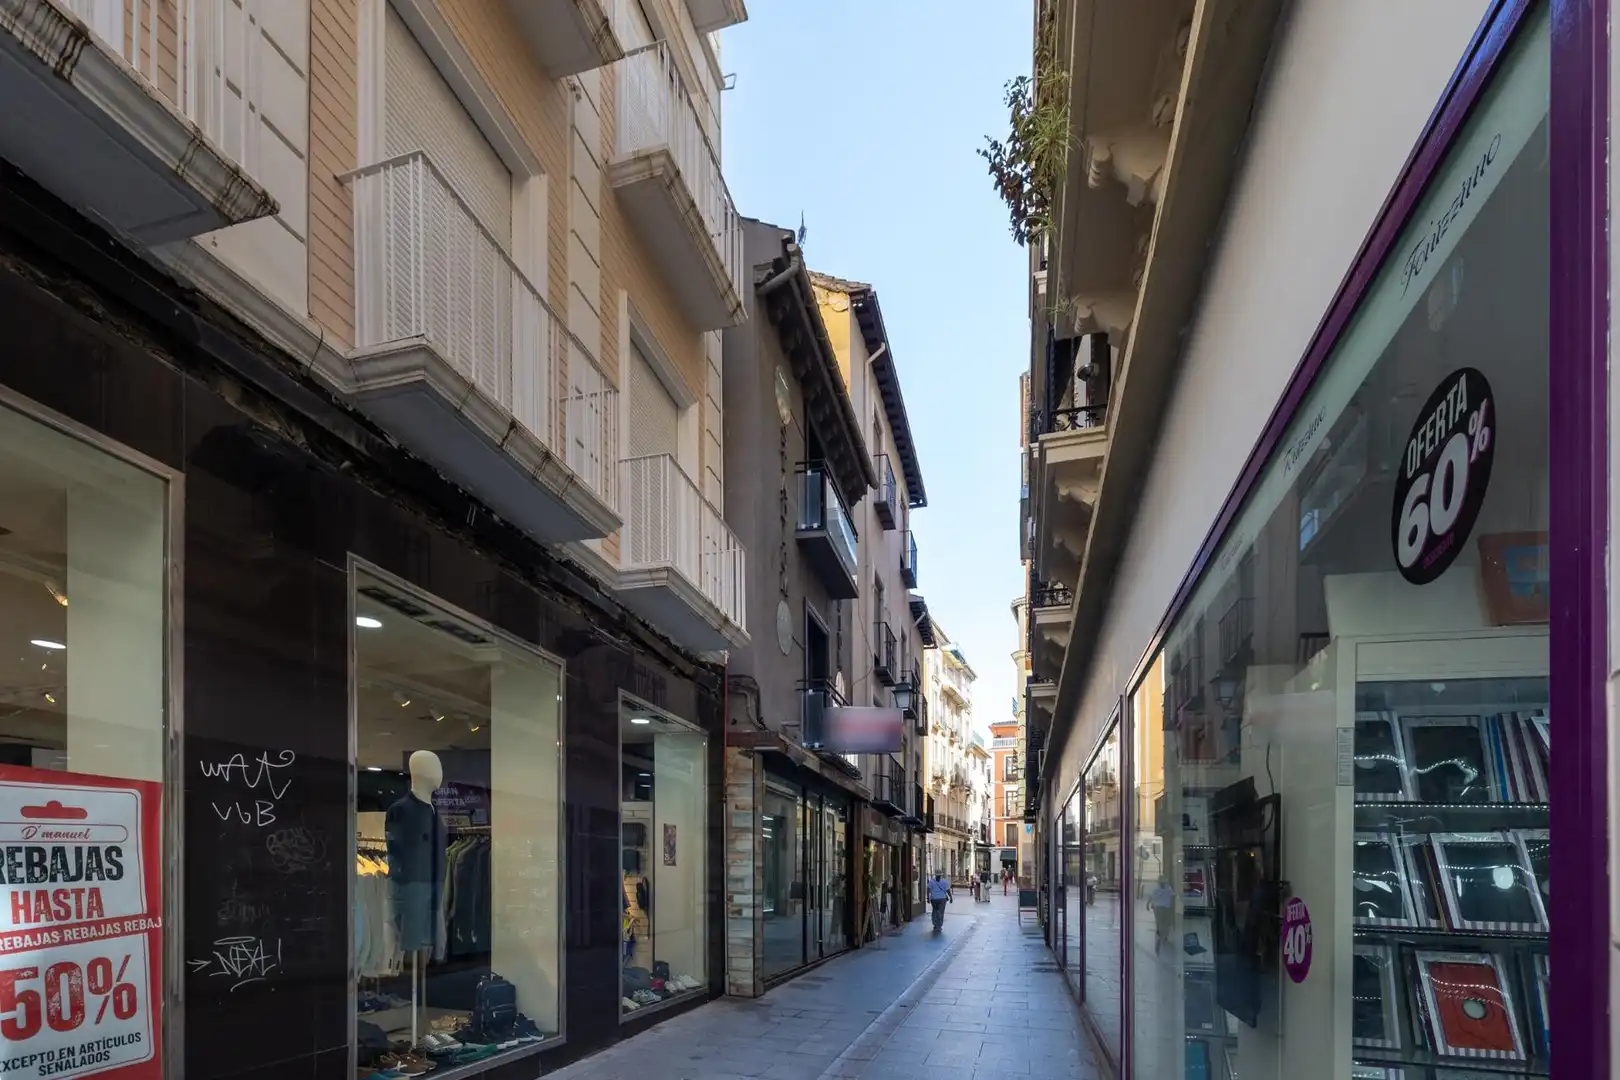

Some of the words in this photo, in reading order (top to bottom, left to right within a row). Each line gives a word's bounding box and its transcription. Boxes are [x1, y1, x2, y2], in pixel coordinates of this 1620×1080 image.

[1407, 373, 1468, 479] OFERTA
[1398, 398, 1492, 568] 60%
[10, 887, 105, 924] HASTA
[64, 922, 121, 942] REBAJAS
[124, 916, 163, 933] REBAJ
[0, 954, 138, 1042] 50%
[0, 1050, 55, 1073] XCEPTO
[58, 1045, 76, 1060] EN
[79, 1032, 142, 1056] ARTÍCULOS
